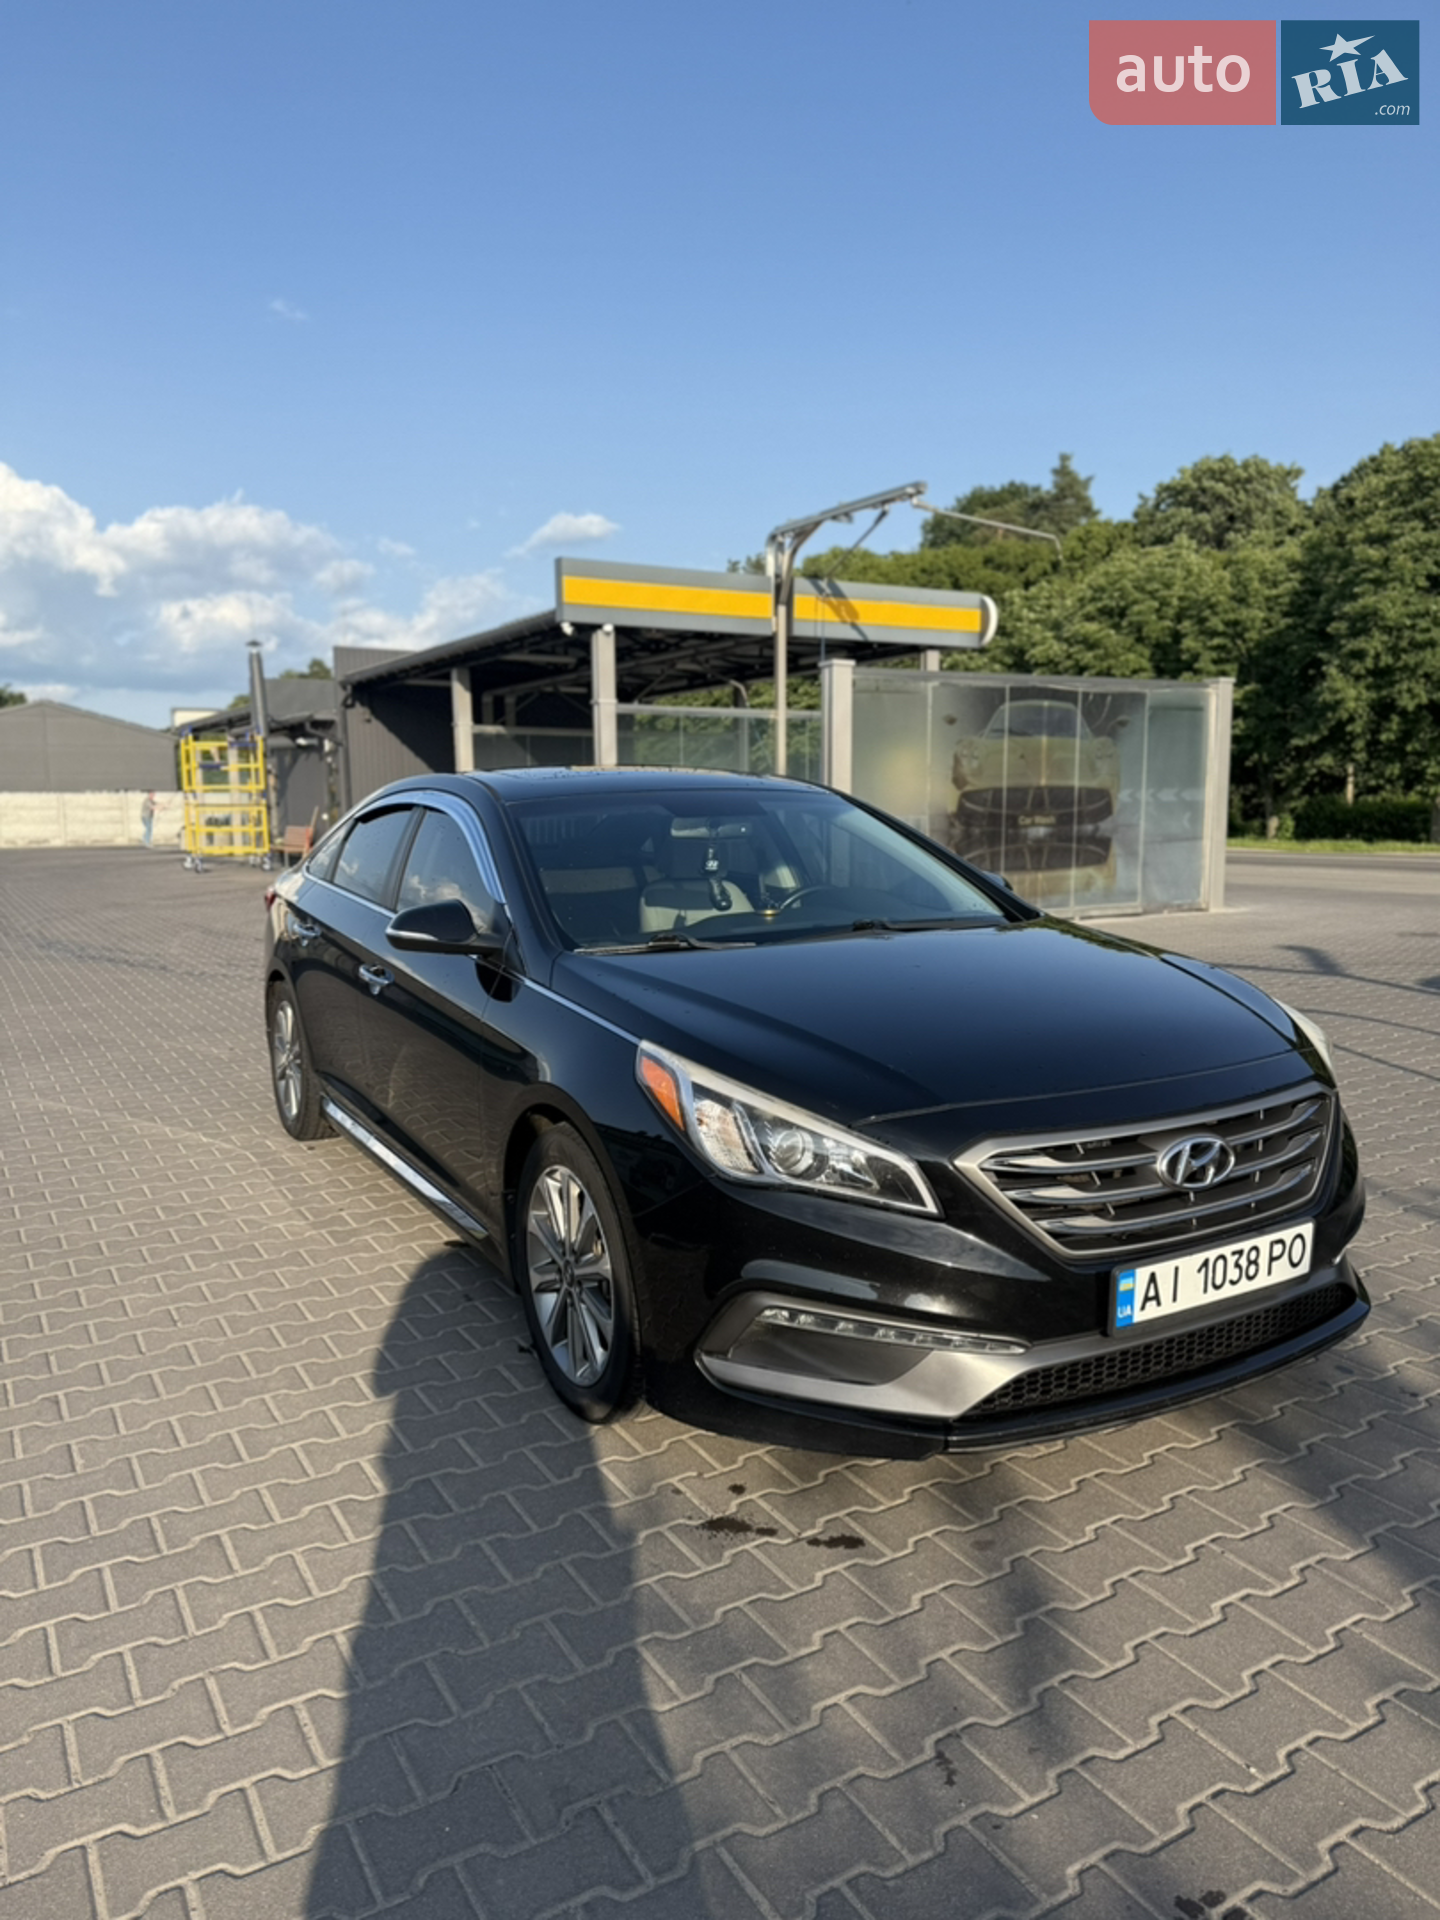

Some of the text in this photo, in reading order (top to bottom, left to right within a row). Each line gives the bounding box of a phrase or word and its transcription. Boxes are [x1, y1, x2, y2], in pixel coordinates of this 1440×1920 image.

[1140, 1233, 1306, 1312] AI 1038 PO
[1117, 1304, 1132, 1318] UA
